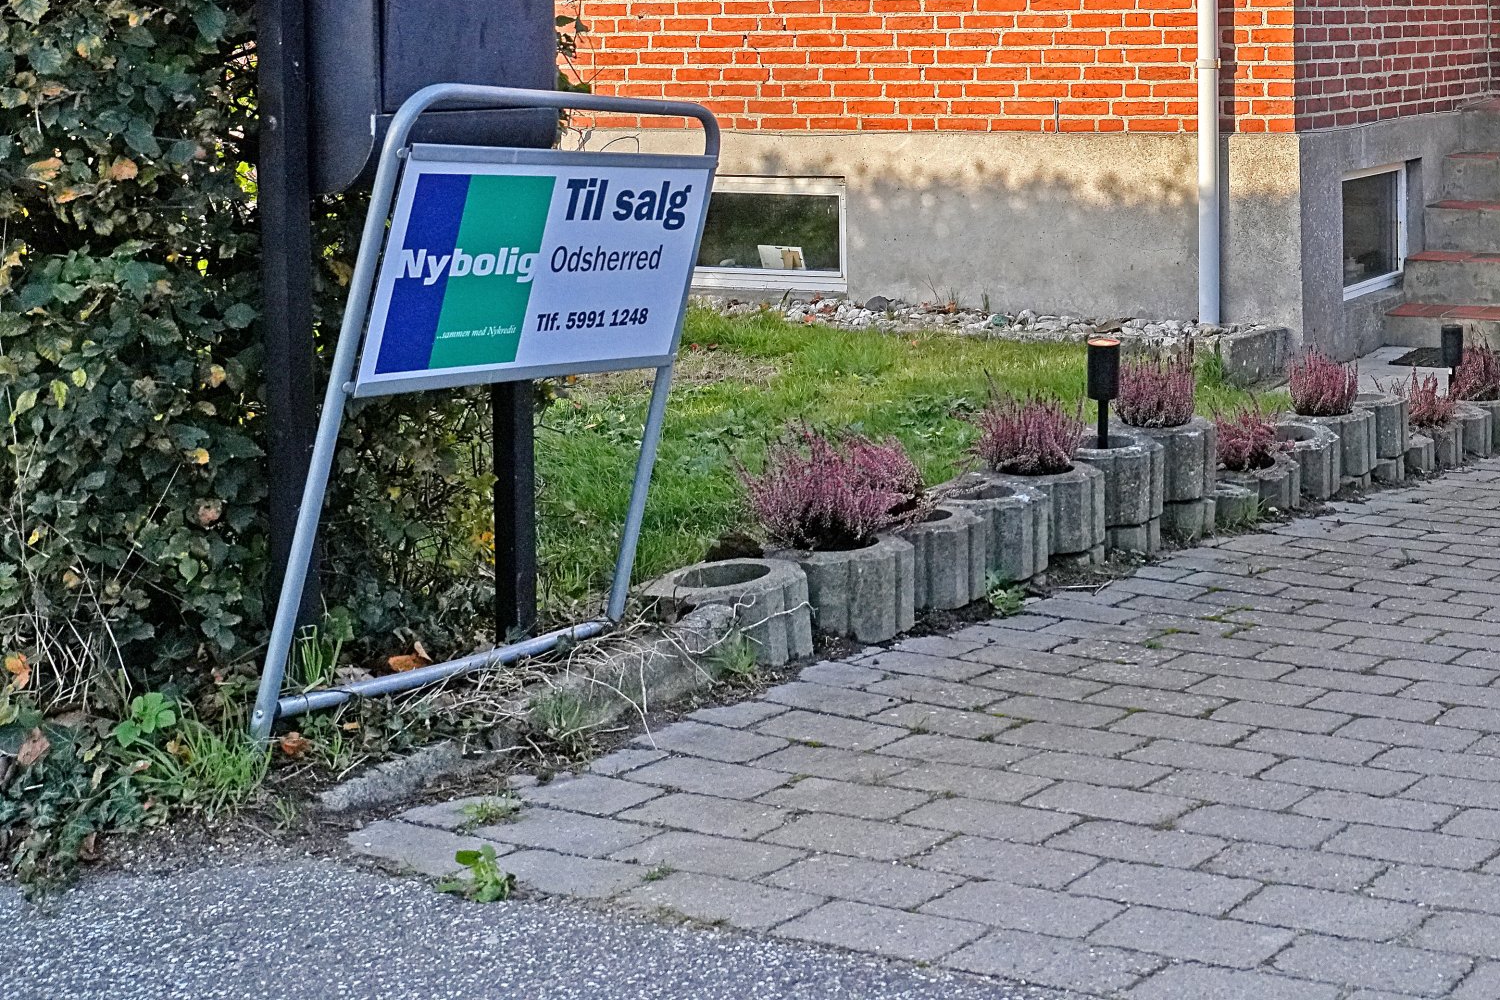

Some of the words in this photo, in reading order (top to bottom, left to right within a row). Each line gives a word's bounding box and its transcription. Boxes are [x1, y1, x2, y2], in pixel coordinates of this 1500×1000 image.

[565, 177, 609, 221] Til
[613, 181, 692, 230] salg
[396, 247, 541, 286] Nybolig
[551, 244, 663, 272] Odsherred
[471, 326, 488, 337] med
[487, 324, 517, 337] Nykredit
[536, 312, 561, 332] Tlf.
[565, 310, 606, 330] 5991
[609, 307, 649, 327] 1248
